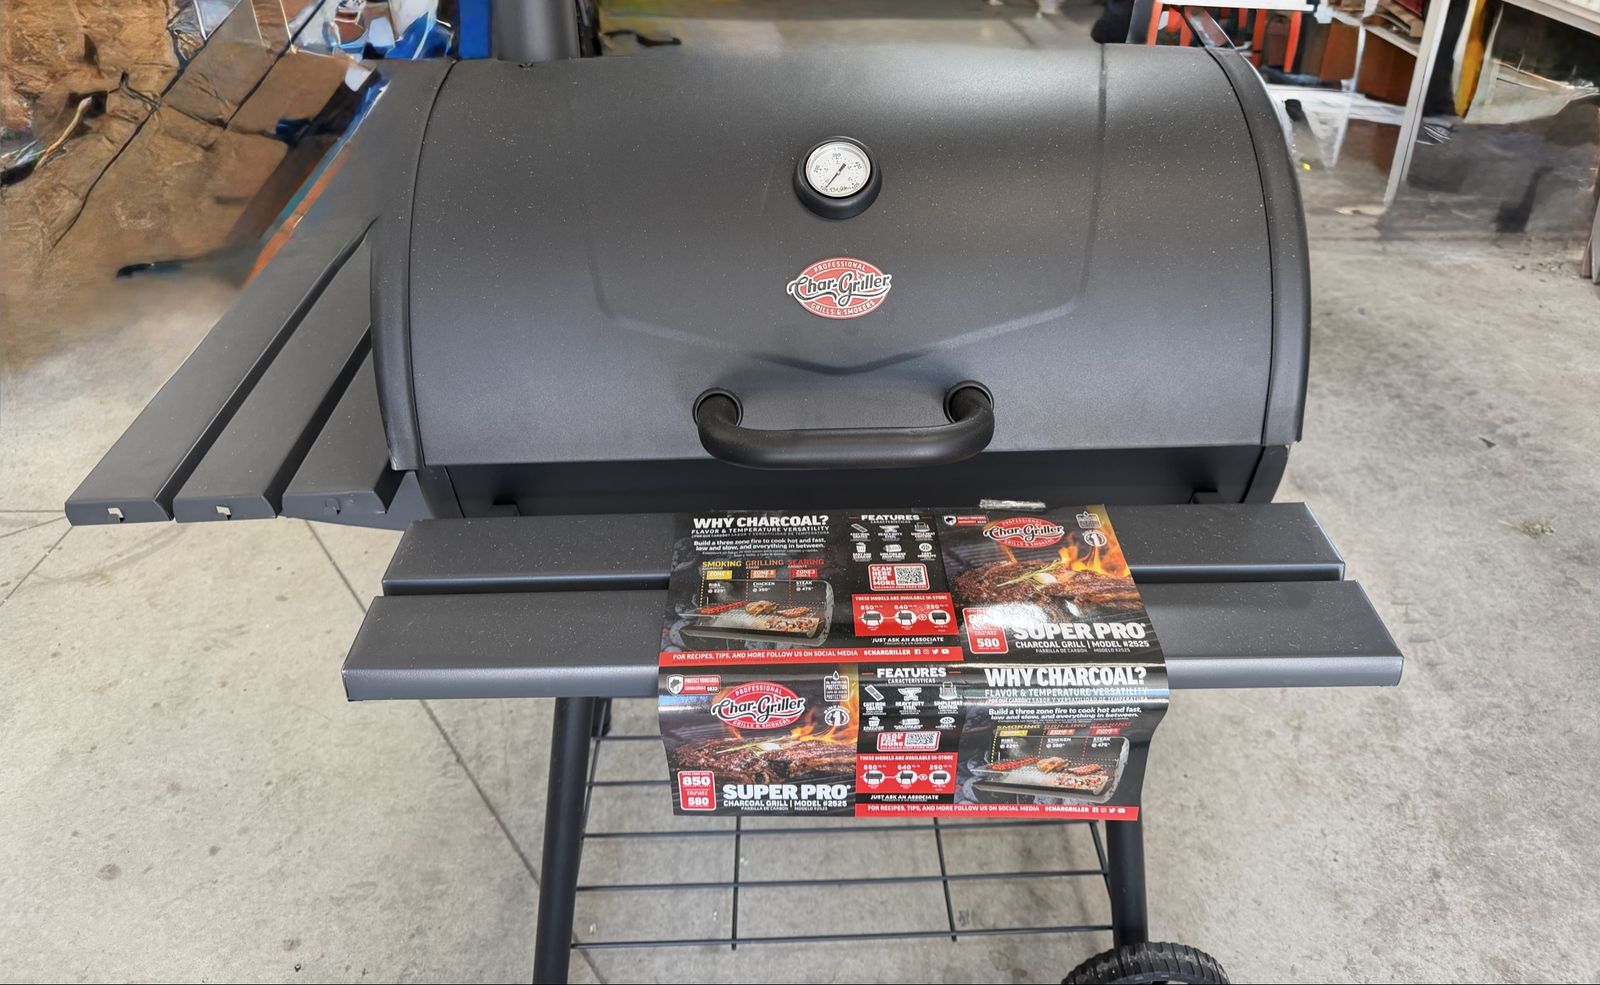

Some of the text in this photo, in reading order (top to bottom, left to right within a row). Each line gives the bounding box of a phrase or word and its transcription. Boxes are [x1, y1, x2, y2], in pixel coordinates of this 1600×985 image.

[814, 261, 865, 272] PROFESSIONAL
[787, 271, 892, 308] Char-Griller
[810, 302, 835, 315] GRILLS
[843, 301, 875, 315] SMOKERS
[693, 515, 829, 529] WHY CHARCOAL?
[983, 524, 1064, 542] Char-Griller
[1013, 623, 1146, 639] SUPER PRO
[977, 638, 1000, 647] 580
[877, 668, 947, 678] FEATURES
[984, 667, 1147, 687] WHY CHARCOAL?
[735, 685, 782, 696] PROFESSIONAL
[985, 689, 1018, 697] FLAVOR
[1092, 688, 1147, 696] VERSATILITY
[711, 695, 807, 723] Char-Griller
[732, 720, 753, 728] GRILLS
[762, 718, 790, 728] SMOKERS
[683, 777, 710, 785] 850
[723, 784, 847, 799] SUPER PRO
[688, 797, 709, 805] 580
